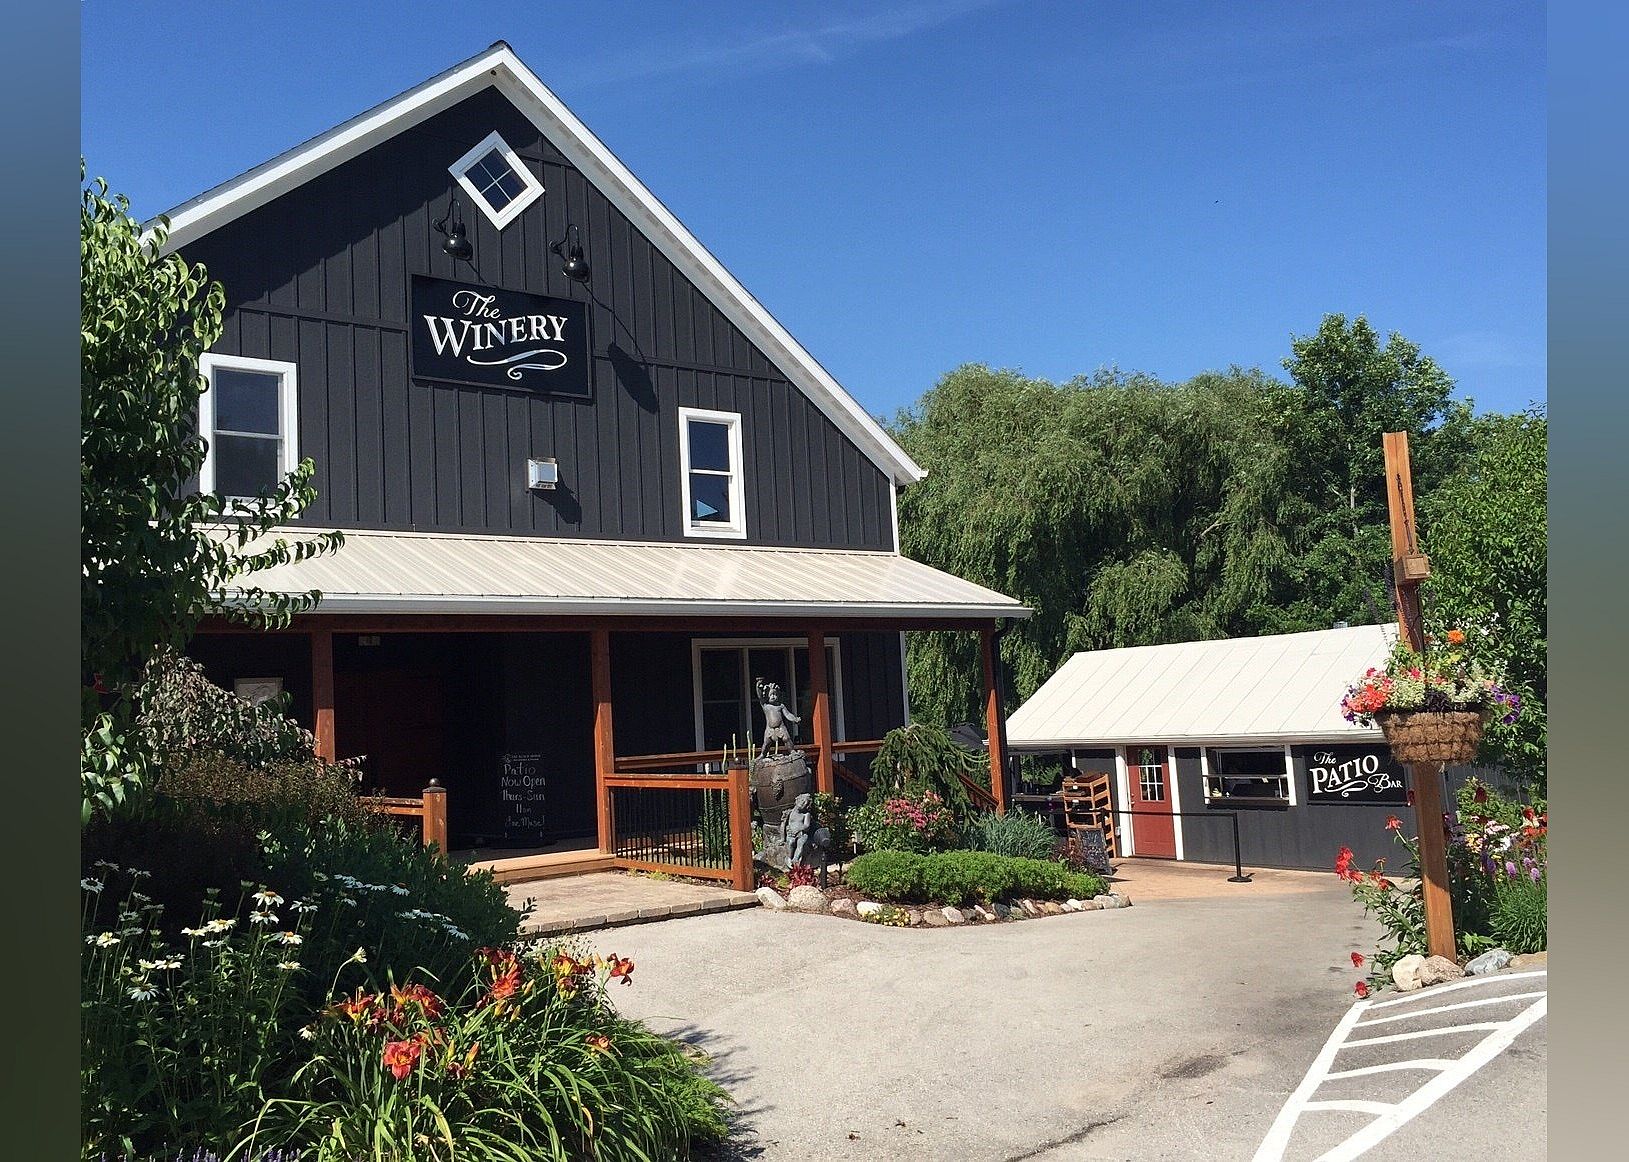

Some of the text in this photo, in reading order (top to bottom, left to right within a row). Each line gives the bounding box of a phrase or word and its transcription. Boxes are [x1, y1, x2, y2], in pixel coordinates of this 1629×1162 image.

[452, 290, 501, 320] The
[423, 314, 569, 358] WINERY
[504, 762, 536, 775] Patio
[1313, 751, 1337, 765] The
[501, 775, 546, 789] Now Open
[1309, 754, 1379, 794] PATIO
